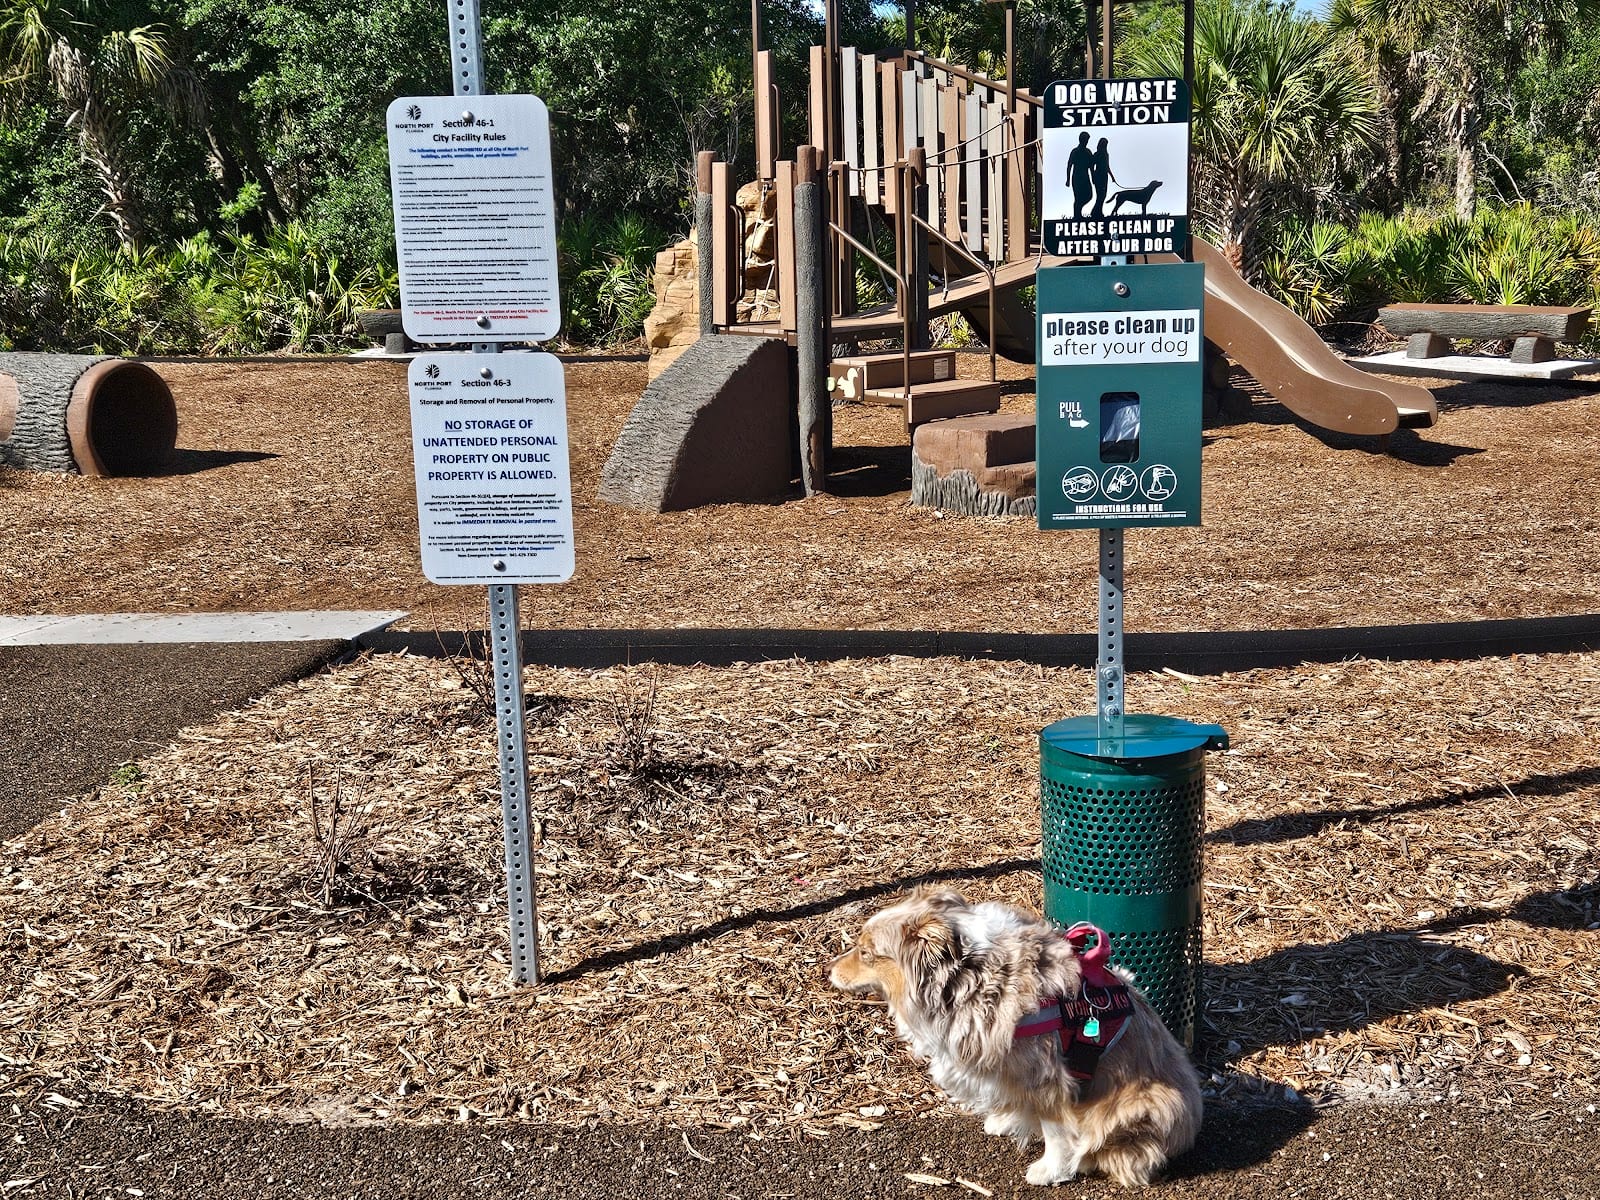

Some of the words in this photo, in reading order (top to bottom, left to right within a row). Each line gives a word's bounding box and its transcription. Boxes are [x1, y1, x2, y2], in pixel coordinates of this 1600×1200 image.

[1054, 84, 1096, 104] DOG
[1105, 80, 1177, 102] WASTE
[1062, 106, 1170, 126] STATION
[433, 134, 449, 143] City
[451, 133, 481, 142] Facility
[483, 133, 506, 141] Rules
[1055, 222, 1104, 236] PLEASE
[1109, 220, 1151, 234] CLEAN
[1157, 219, 1175, 233] UP
[1058, 240, 1098, 255] AFTER
[1103, 239, 1139, 253] YOUR
[1144, 238, 1172, 251] DOG
[1047, 319, 1109, 338] please
[1115, 316, 1166, 334] clean
[1172, 317, 1195, 334] up
[1053, 338, 1096, 356] after
[1103, 340, 1146, 359] your
[1152, 337, 1188, 356] dog
[1060, 402, 1082, 413] PULL
[445, 420, 462, 430] NO
[466, 420, 516, 430] STORAGE
[519, 420, 533, 428] OF
[423, 437, 498, 447] UNATTENDED
[501, 436, 558, 446] PERSONAL
[432, 454, 488, 464] PROPERTY
[492, 454, 508, 463] ON
[512, 453, 550, 462] PUBLIC
[428, 471, 484, 480] PROPERTY
[488, 471, 497, 480] IS
[500, 470, 556, 480] ALLOWED.
[1076, 504, 1130, 513] INSTRUCTIONS
[1132, 504, 1146, 512] FOR
[1148, 504, 1162, 512] USE
